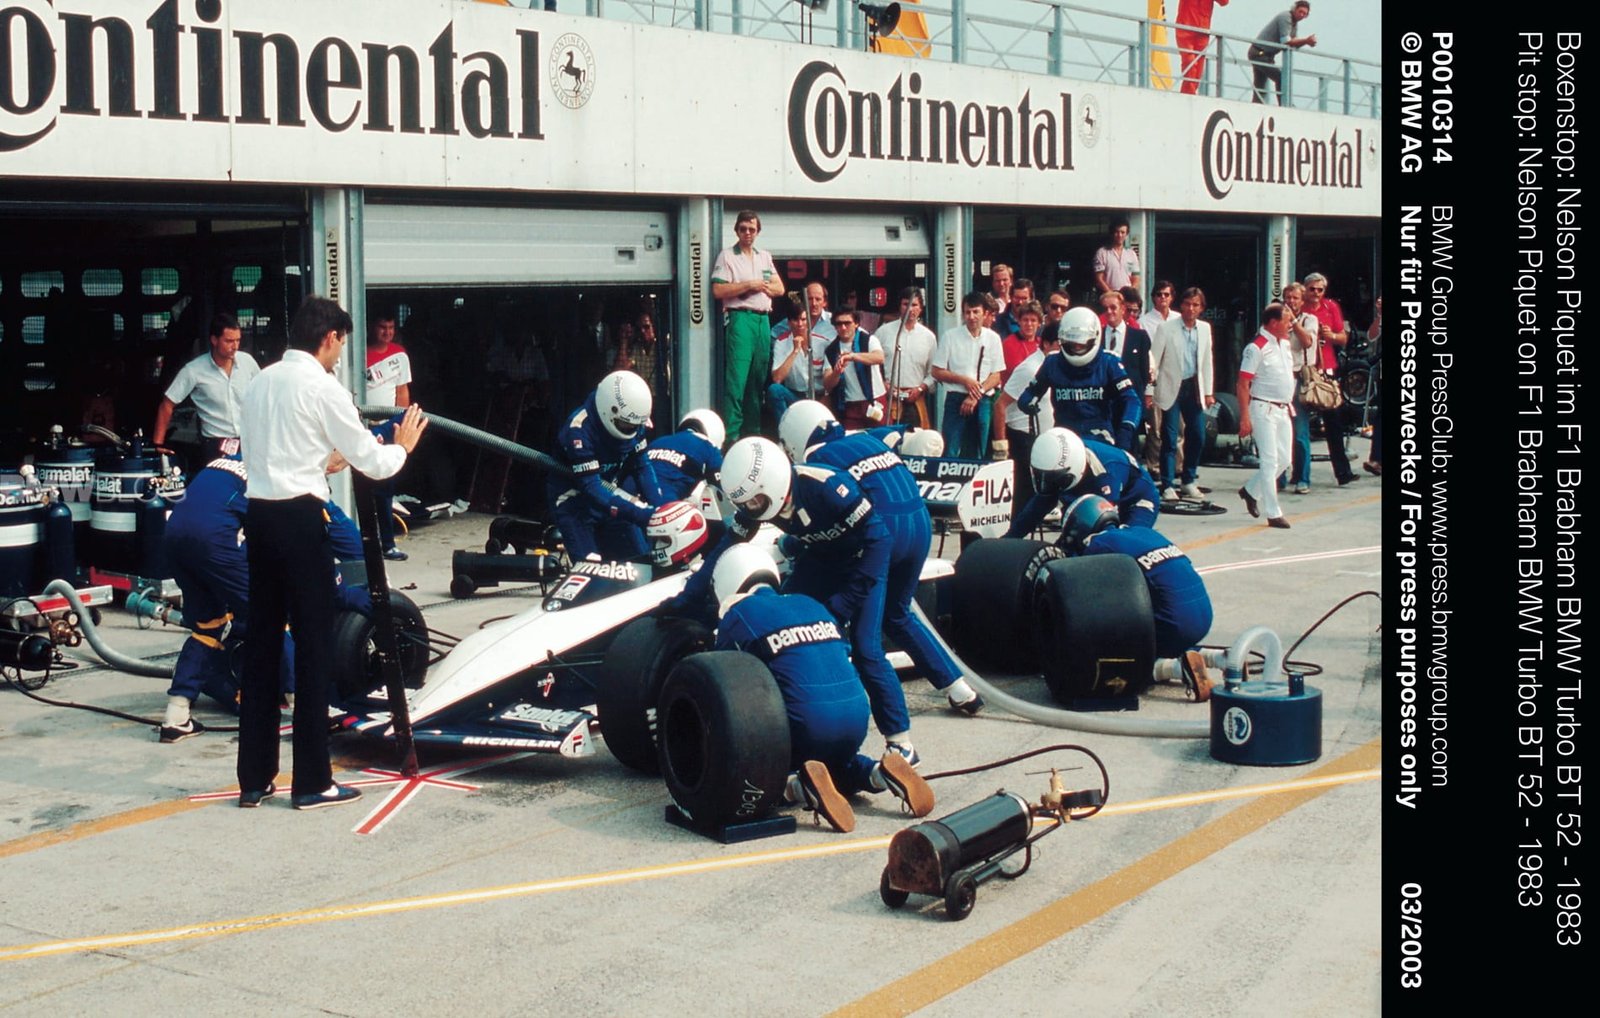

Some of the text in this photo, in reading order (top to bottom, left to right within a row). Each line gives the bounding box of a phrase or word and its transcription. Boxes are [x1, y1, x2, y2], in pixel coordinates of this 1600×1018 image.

[787, 60, 1075, 183] Continental
[1200, 110, 1362, 200] Continental
[326, 242, 339, 299] nental
[690, 242, 704, 325] Continental
[944, 243, 956, 313] Continental
[1056, 387, 1103, 402] parmalat
[647, 449, 686, 468] malat
[972, 478, 1012, 507] FILA
[970, 513, 1010, 528] MICHELIN
[767, 619, 841, 653] parmalat
[462, 736, 561, 748] MICHELIN
